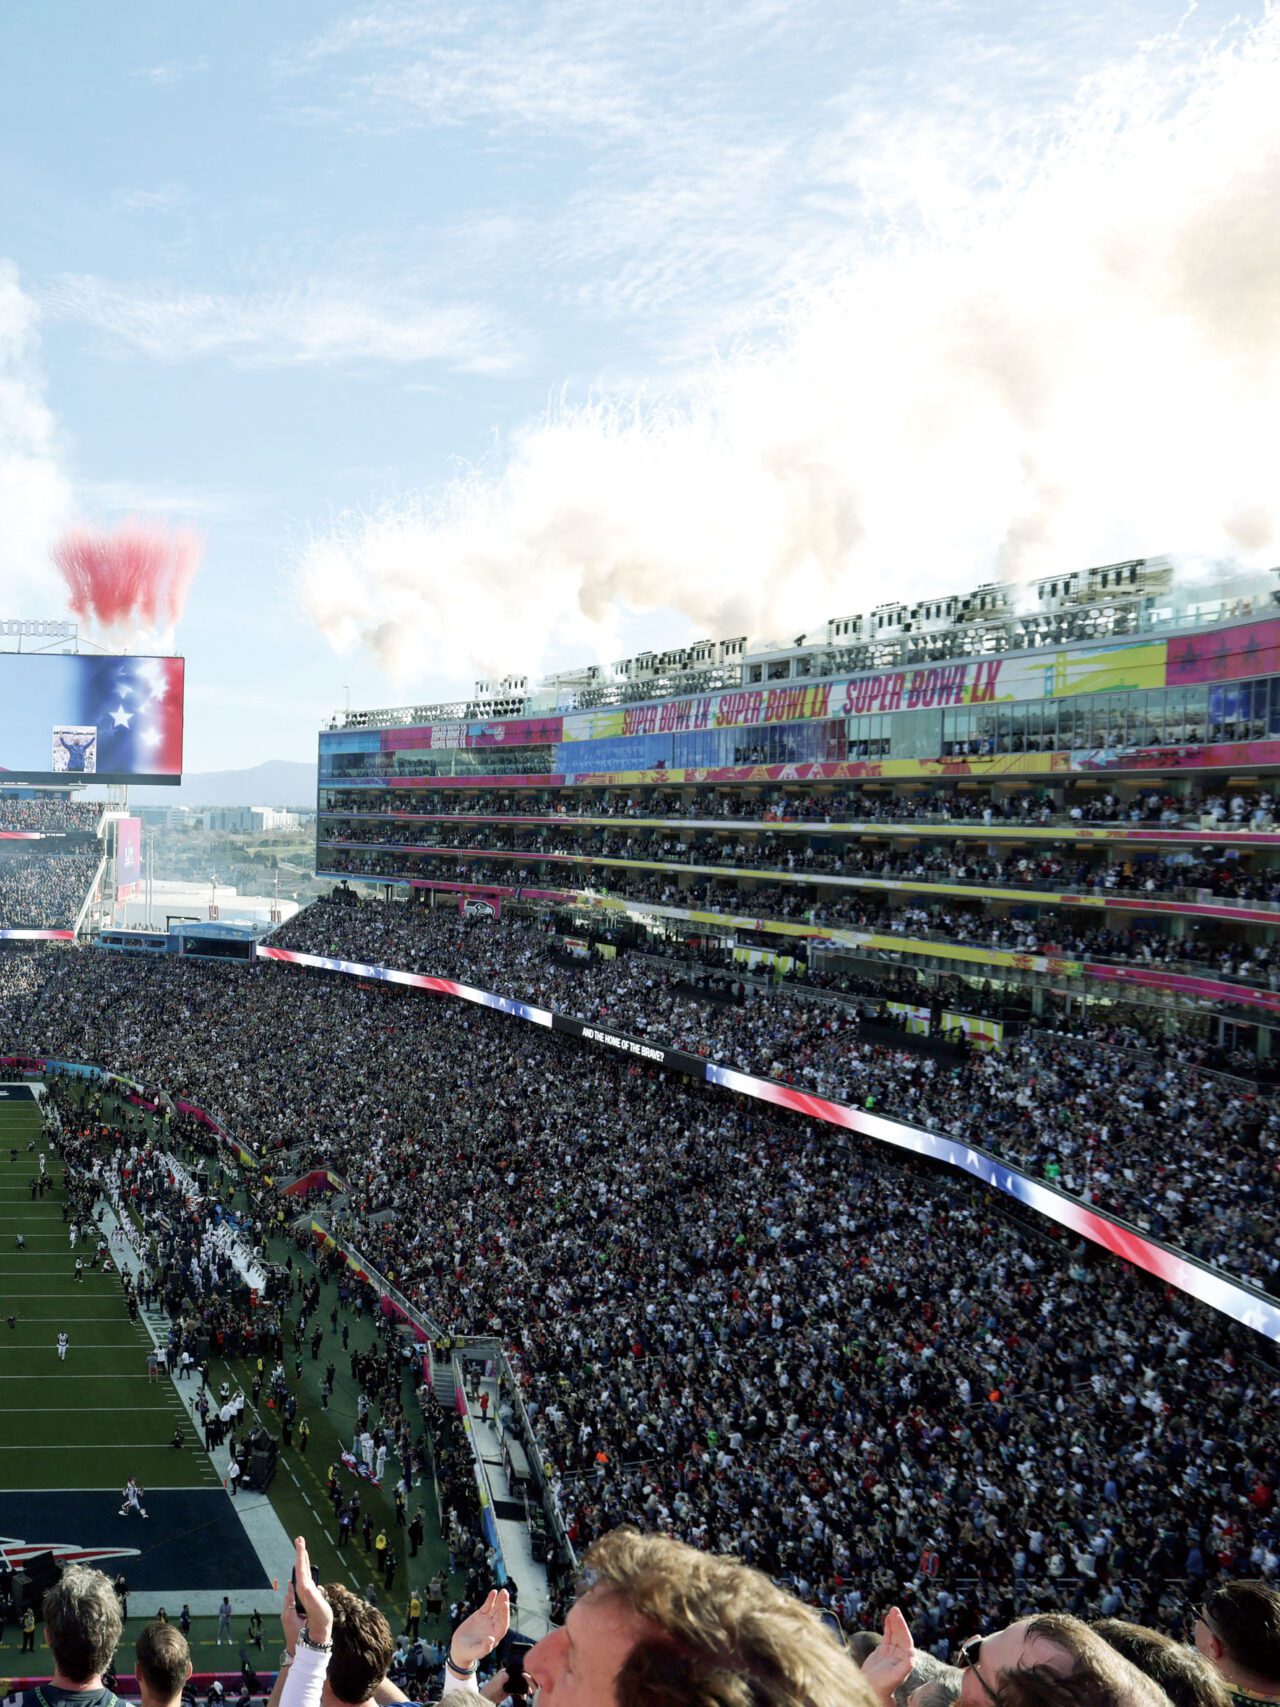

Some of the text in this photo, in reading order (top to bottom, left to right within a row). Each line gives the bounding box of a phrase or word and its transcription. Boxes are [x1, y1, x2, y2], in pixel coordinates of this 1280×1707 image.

[716, 680, 834, 726] SUPER BOWL LX
[842, 659, 1004, 716] SUPER BOWL LX
[621, 697, 712, 736] SUPER BOWL LX
[582, 1027, 664, 1062] AND THE HOME OF THE BRAVE?
